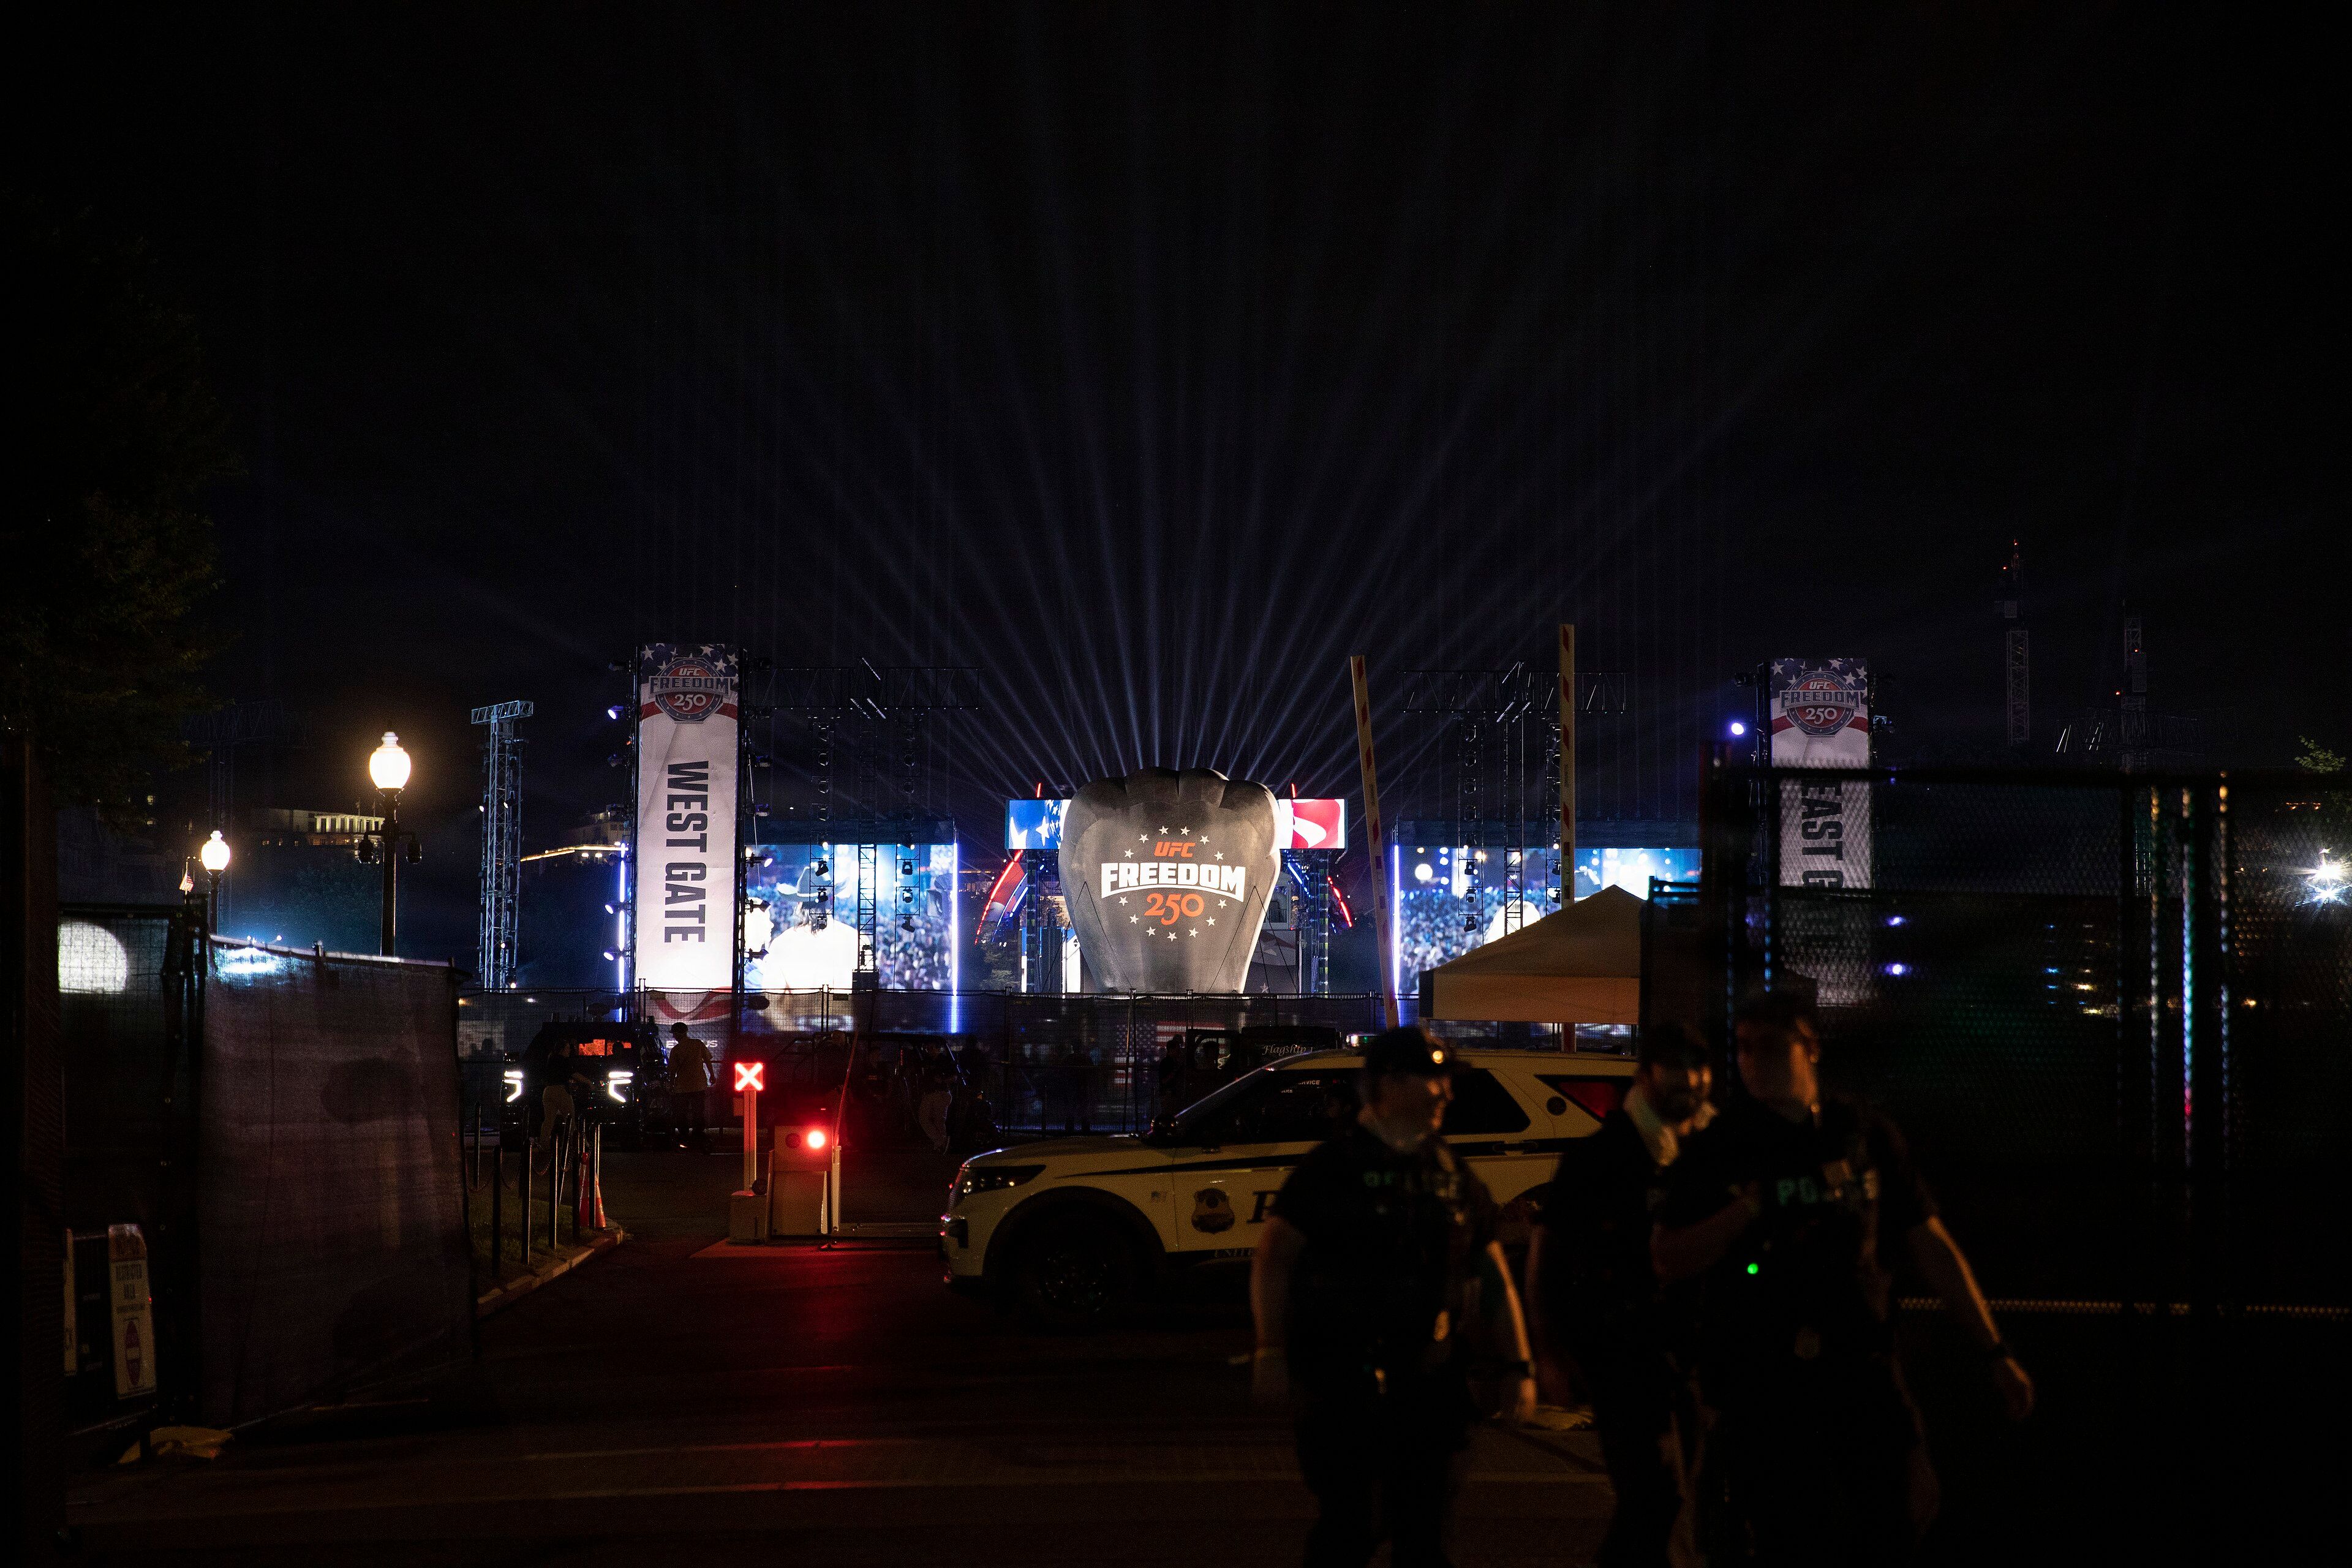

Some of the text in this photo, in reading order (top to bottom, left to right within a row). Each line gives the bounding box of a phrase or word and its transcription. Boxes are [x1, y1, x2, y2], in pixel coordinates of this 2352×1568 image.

[679, 668, 701, 676] UFC
[649, 676, 730, 696] FREEDOM
[674, 694, 706, 710] 250
[1780, 690, 1861, 709] FREEDOM
[1805, 707, 1838, 724] 250
[1801, 778, 1843, 861] EAST
[664, 760, 709, 943] WEST GATE
[1154, 842, 1196, 858] UFC
[1101, 862, 1246, 902] FREEDOM
[1144, 893, 1205, 925] 250
